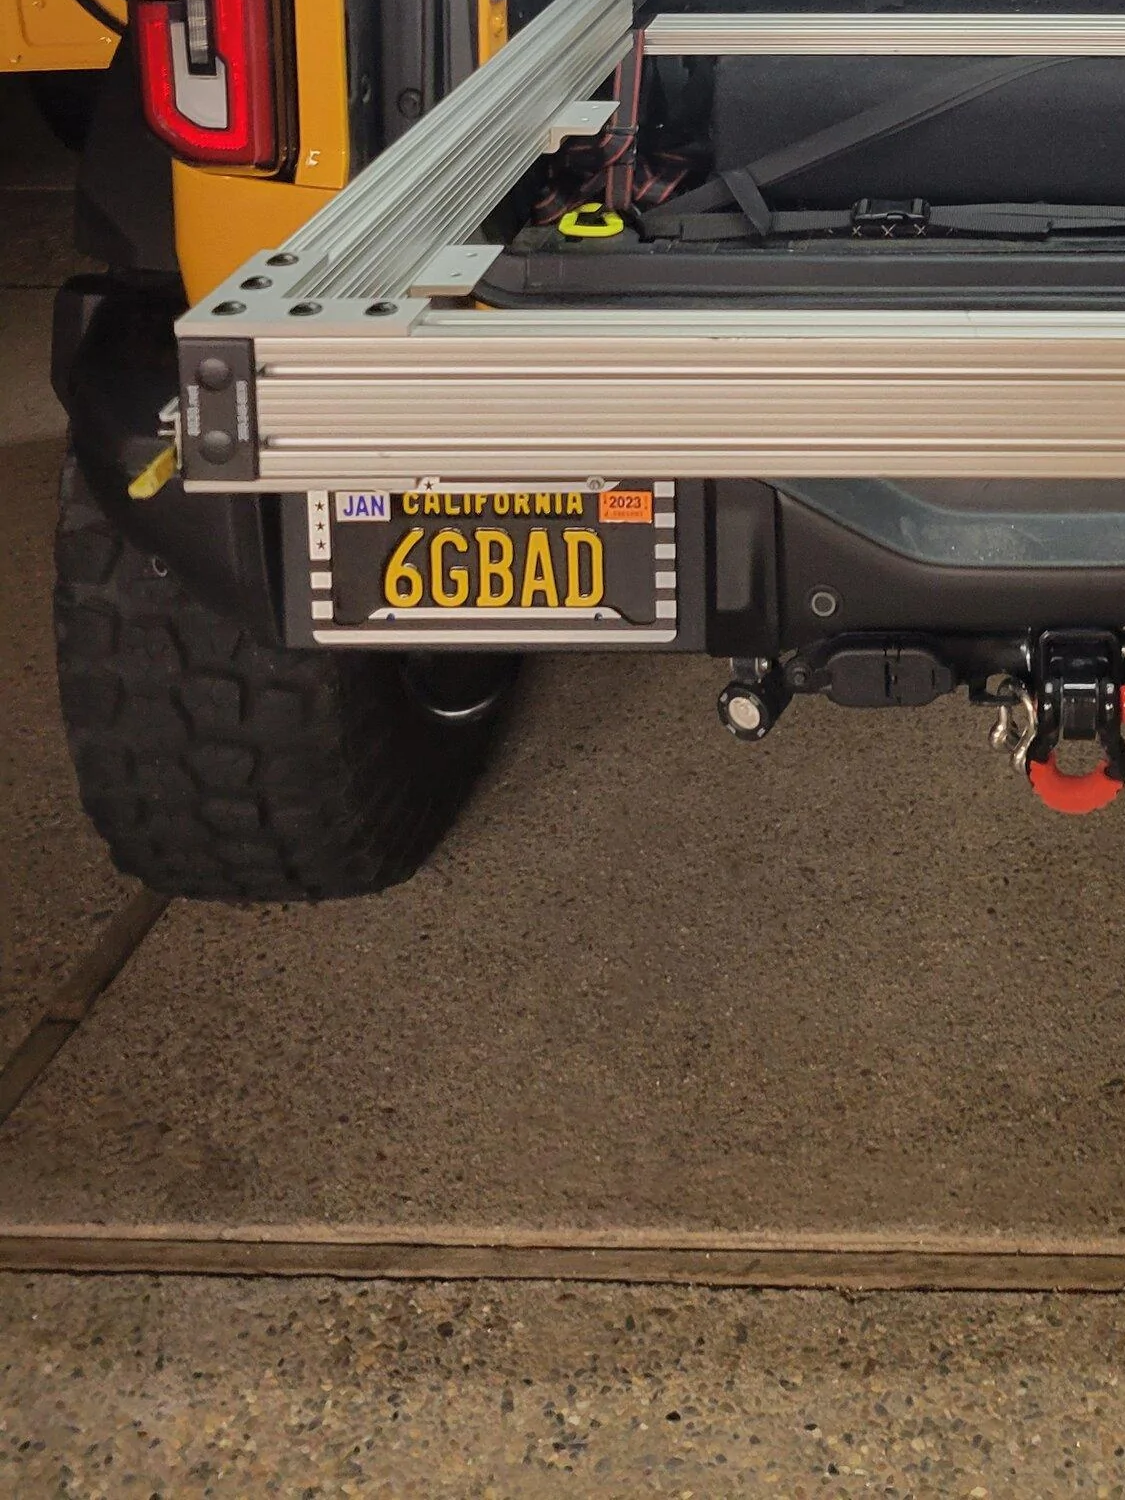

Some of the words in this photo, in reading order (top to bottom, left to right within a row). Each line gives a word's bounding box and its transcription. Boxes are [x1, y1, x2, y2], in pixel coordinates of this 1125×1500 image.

[343, 495, 385, 516] JAN
[402, 491, 584, 515] CALIFORNIA
[608, 495, 642, 509] 2023
[384, 527, 604, 608] 6GBAD
